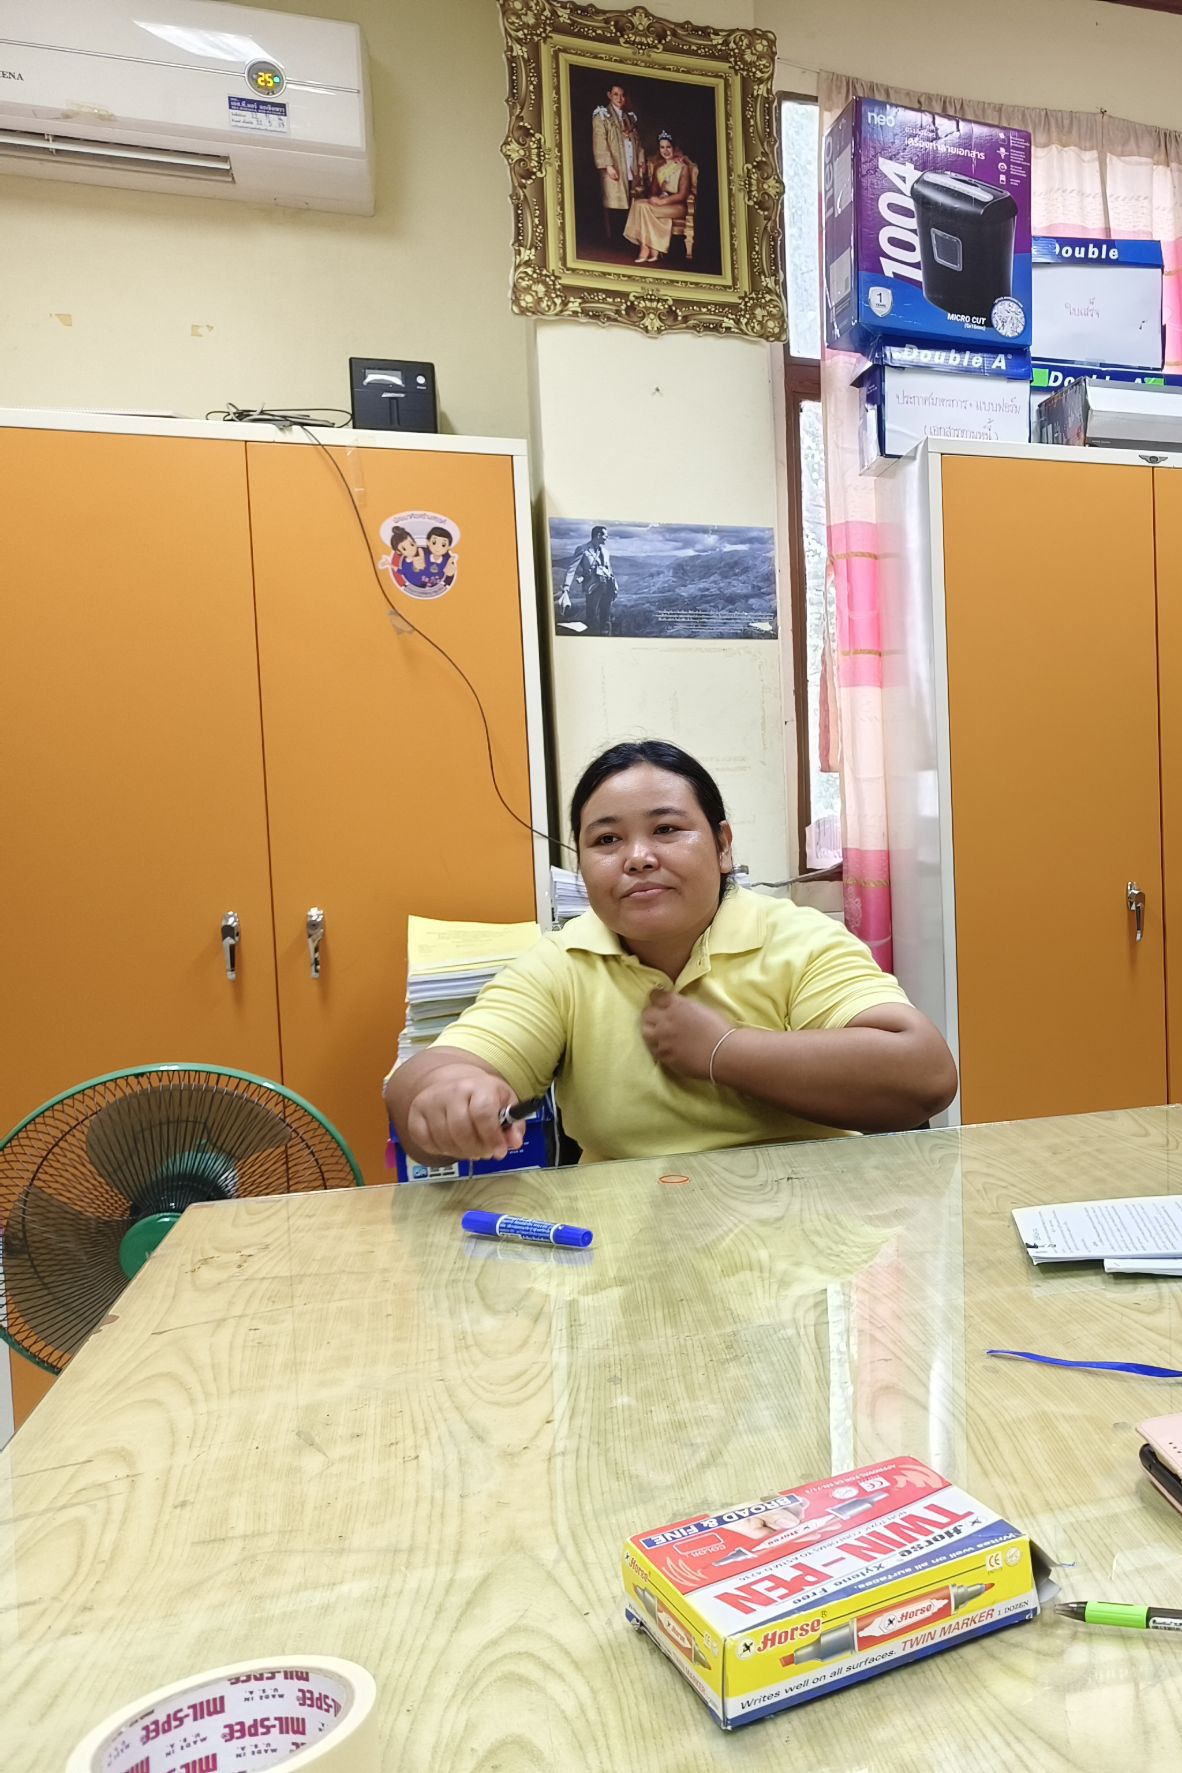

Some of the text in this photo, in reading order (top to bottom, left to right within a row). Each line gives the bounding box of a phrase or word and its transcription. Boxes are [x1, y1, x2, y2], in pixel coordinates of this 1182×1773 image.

[0, 70, 25, 82] ENA
[257, 71, 274, 87] 25
[867, 111, 896, 128] neo
[877, 155, 925, 285] 1004
[947, 313, 987, 325] MICRO CUT
[903, 344, 1007, 371] Double A
[651, 1496, 792, 1546] BROAD & FINE
[898, 1526, 963, 1558] Horse
[897, 1602, 932, 1623] Horse
[757, 1619, 821, 1652] Horse
[740, 1691, 781, 1710] Writes
[784, 1680, 809, 1695] well
[812, 1674, 827, 1685] on
[829, 1667, 843, 1678] all
[845, 1649, 897, 1673] surfaces.
[901, 1630, 936, 1652] TWIN
[939, 1608, 995, 1638] MARKER
[1004, 1599, 1029, 1614] DOZEN
[141, 1695, 226, 1745] MIL-SPEC
[223, 1716, 307, 1743] MIL-SPEC
